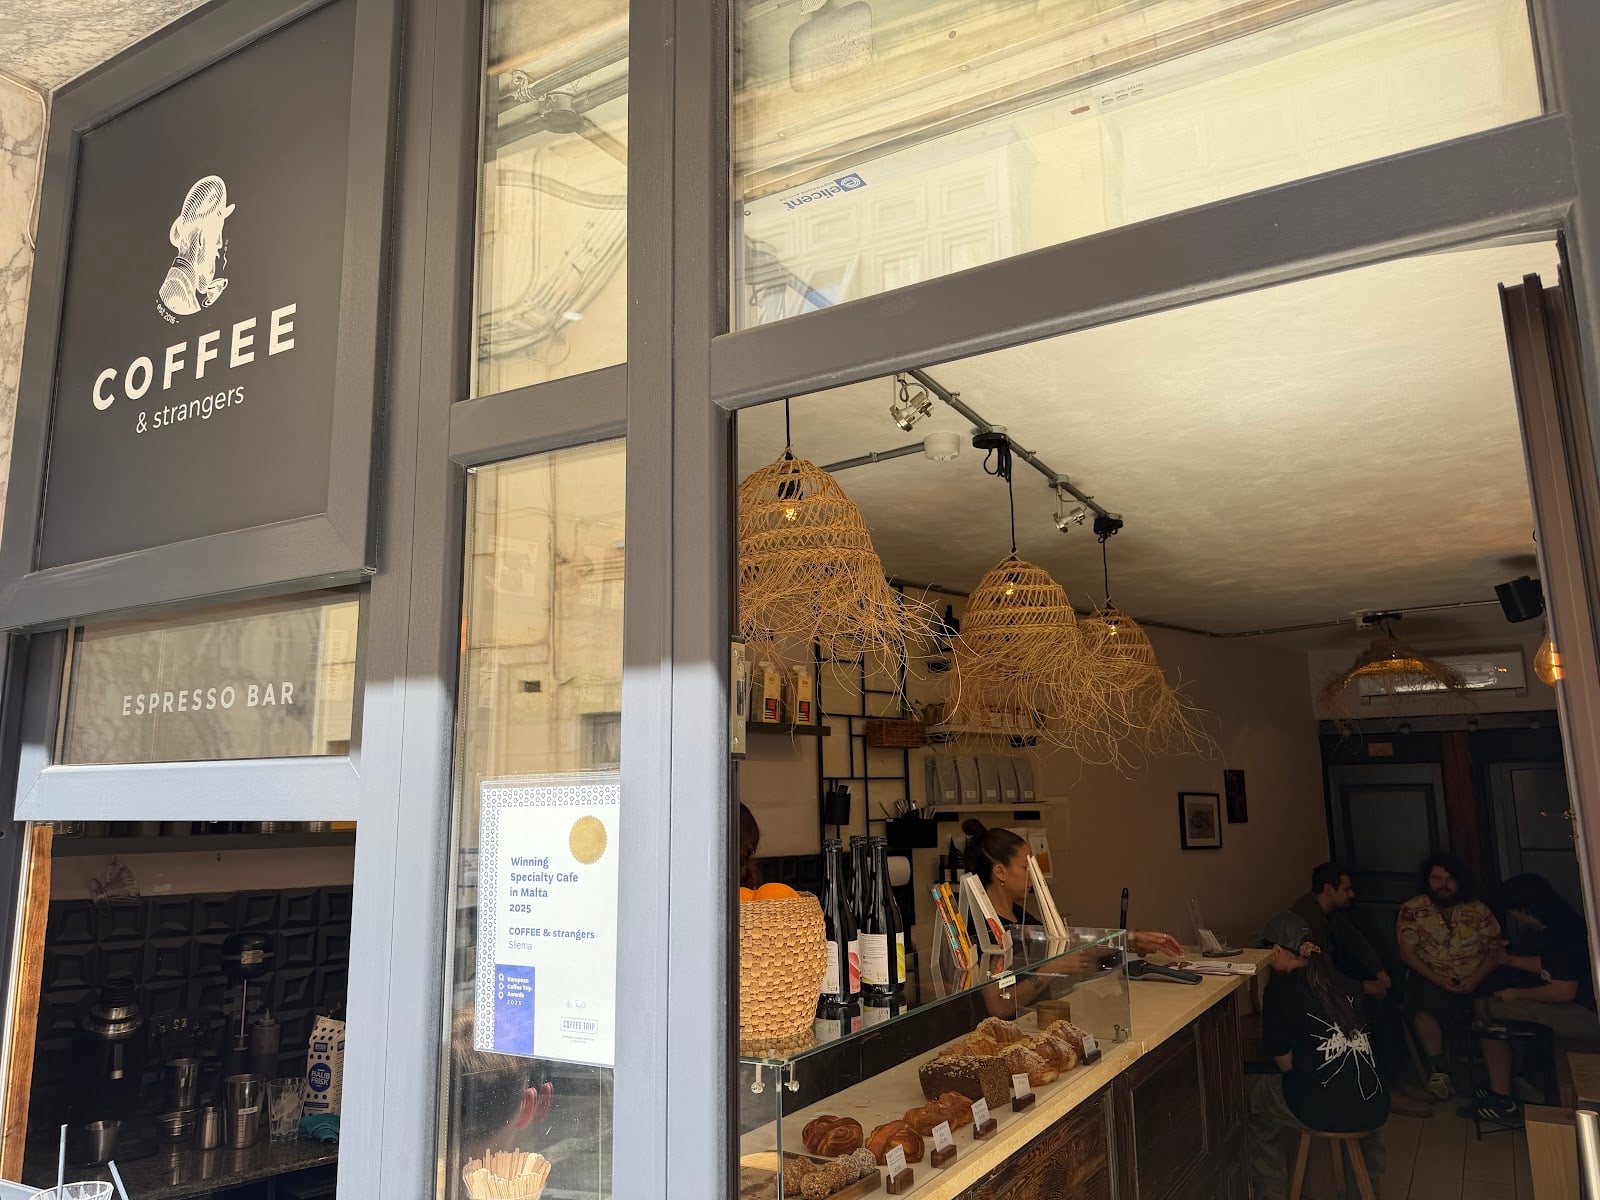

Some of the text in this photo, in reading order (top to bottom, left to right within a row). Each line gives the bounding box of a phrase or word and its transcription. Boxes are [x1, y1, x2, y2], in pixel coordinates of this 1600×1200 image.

[92, 303, 297, 411] COFFEE
[135, 385, 245, 434] & strangers
[122, 681, 295, 716] ESPRESSO BAR
[510, 856, 549, 869] Winning
[510, 871, 578, 884] Specialty Cafe
[509, 886, 548, 898] in Malta
[509, 903, 531, 914] 2025
[508, 927, 595, 941] COFFEE & strangers
